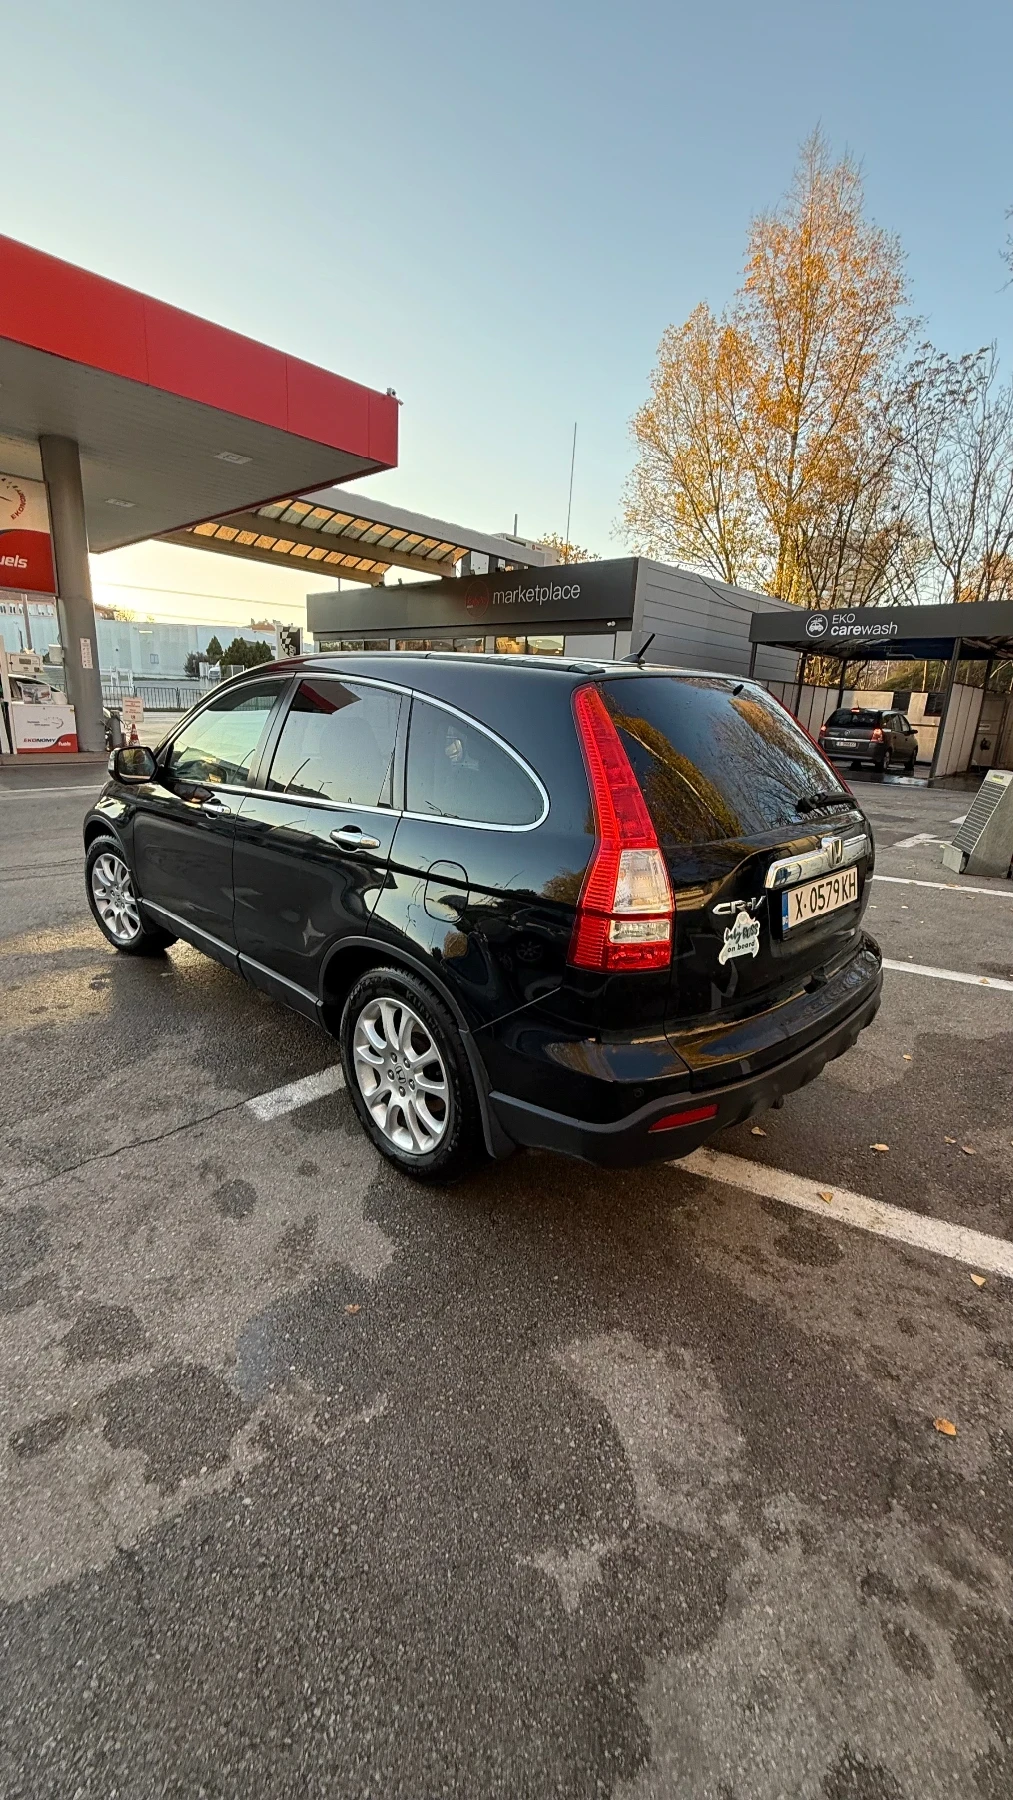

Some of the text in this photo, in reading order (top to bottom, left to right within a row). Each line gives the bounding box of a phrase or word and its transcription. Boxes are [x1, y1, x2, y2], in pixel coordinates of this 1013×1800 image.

[492, 581, 581, 606] marketplace
[832, 613, 856, 624] EKO
[830, 621, 898, 636] carewash
